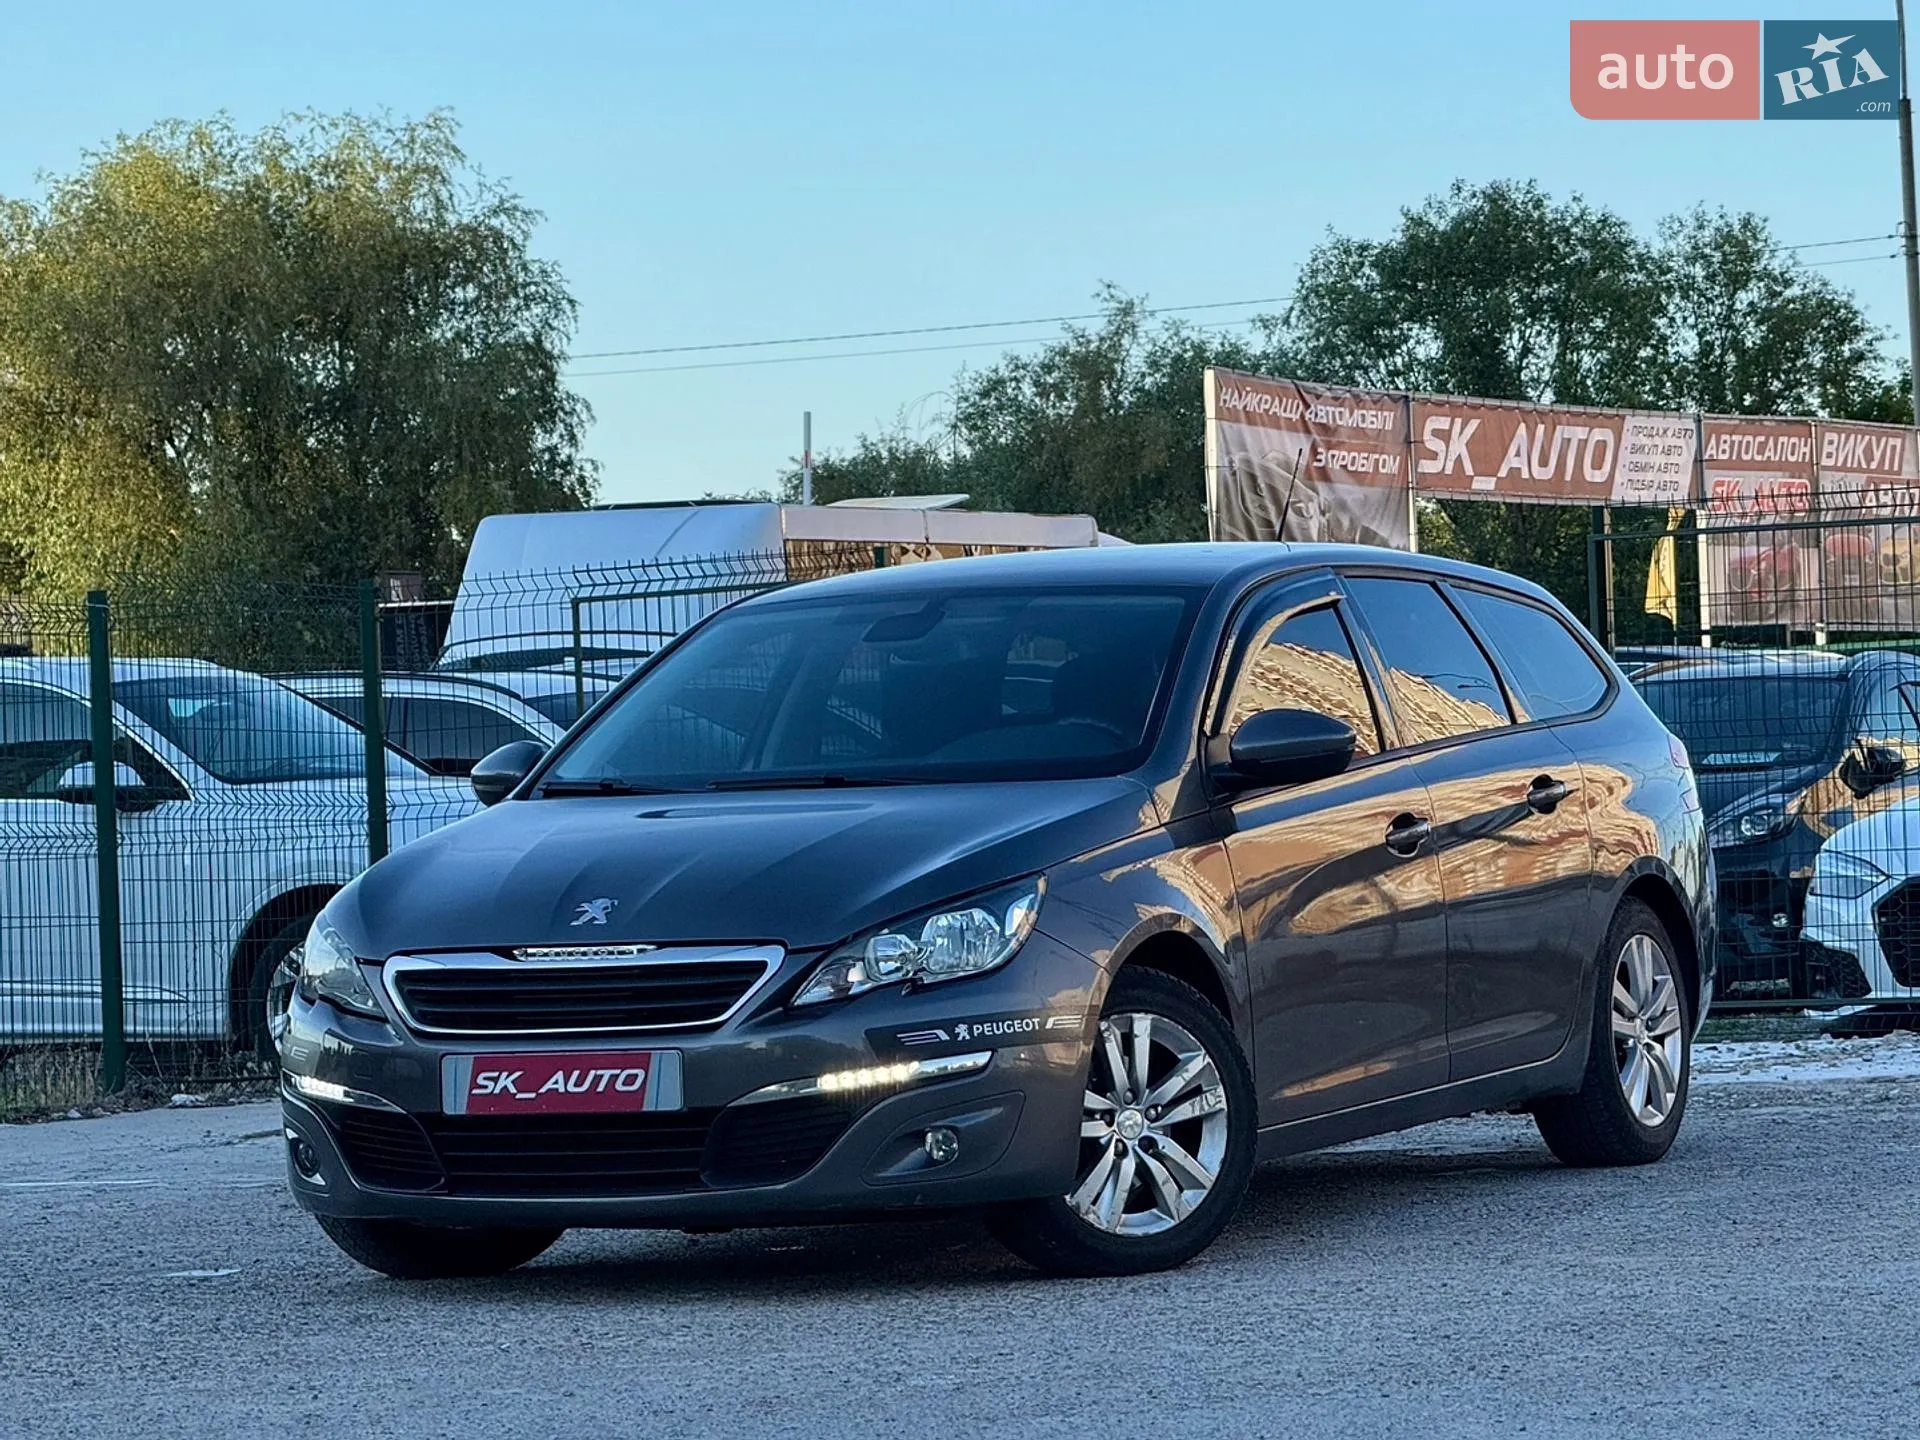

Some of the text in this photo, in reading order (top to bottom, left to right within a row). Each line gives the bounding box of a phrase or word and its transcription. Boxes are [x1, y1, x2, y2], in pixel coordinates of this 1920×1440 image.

[1219, 387, 1395, 430] НАЙКРАЩІ АВТОМОБІЛІ
[1630, 425, 1695, 440] ПРОДАЖ АВТО
[1313, 448, 1400, 474] З ПРОБІГОМ
[1417, 415, 1616, 490] SK_AUTO
[1629, 443, 1683, 457] ВИКУП АВТО
[1705, 433, 1811, 463] АВТОСАЛОН
[1821, 431, 1905, 471] ВИКУП
[1628, 461, 1680, 474] ОБМІН АВТО
[1625, 479, 1680, 492] ПІДБІР АВТО
[972, 1018, 1041, 1037] PEUGEOT
[471, 1068, 646, 1099] SK_AUTO
